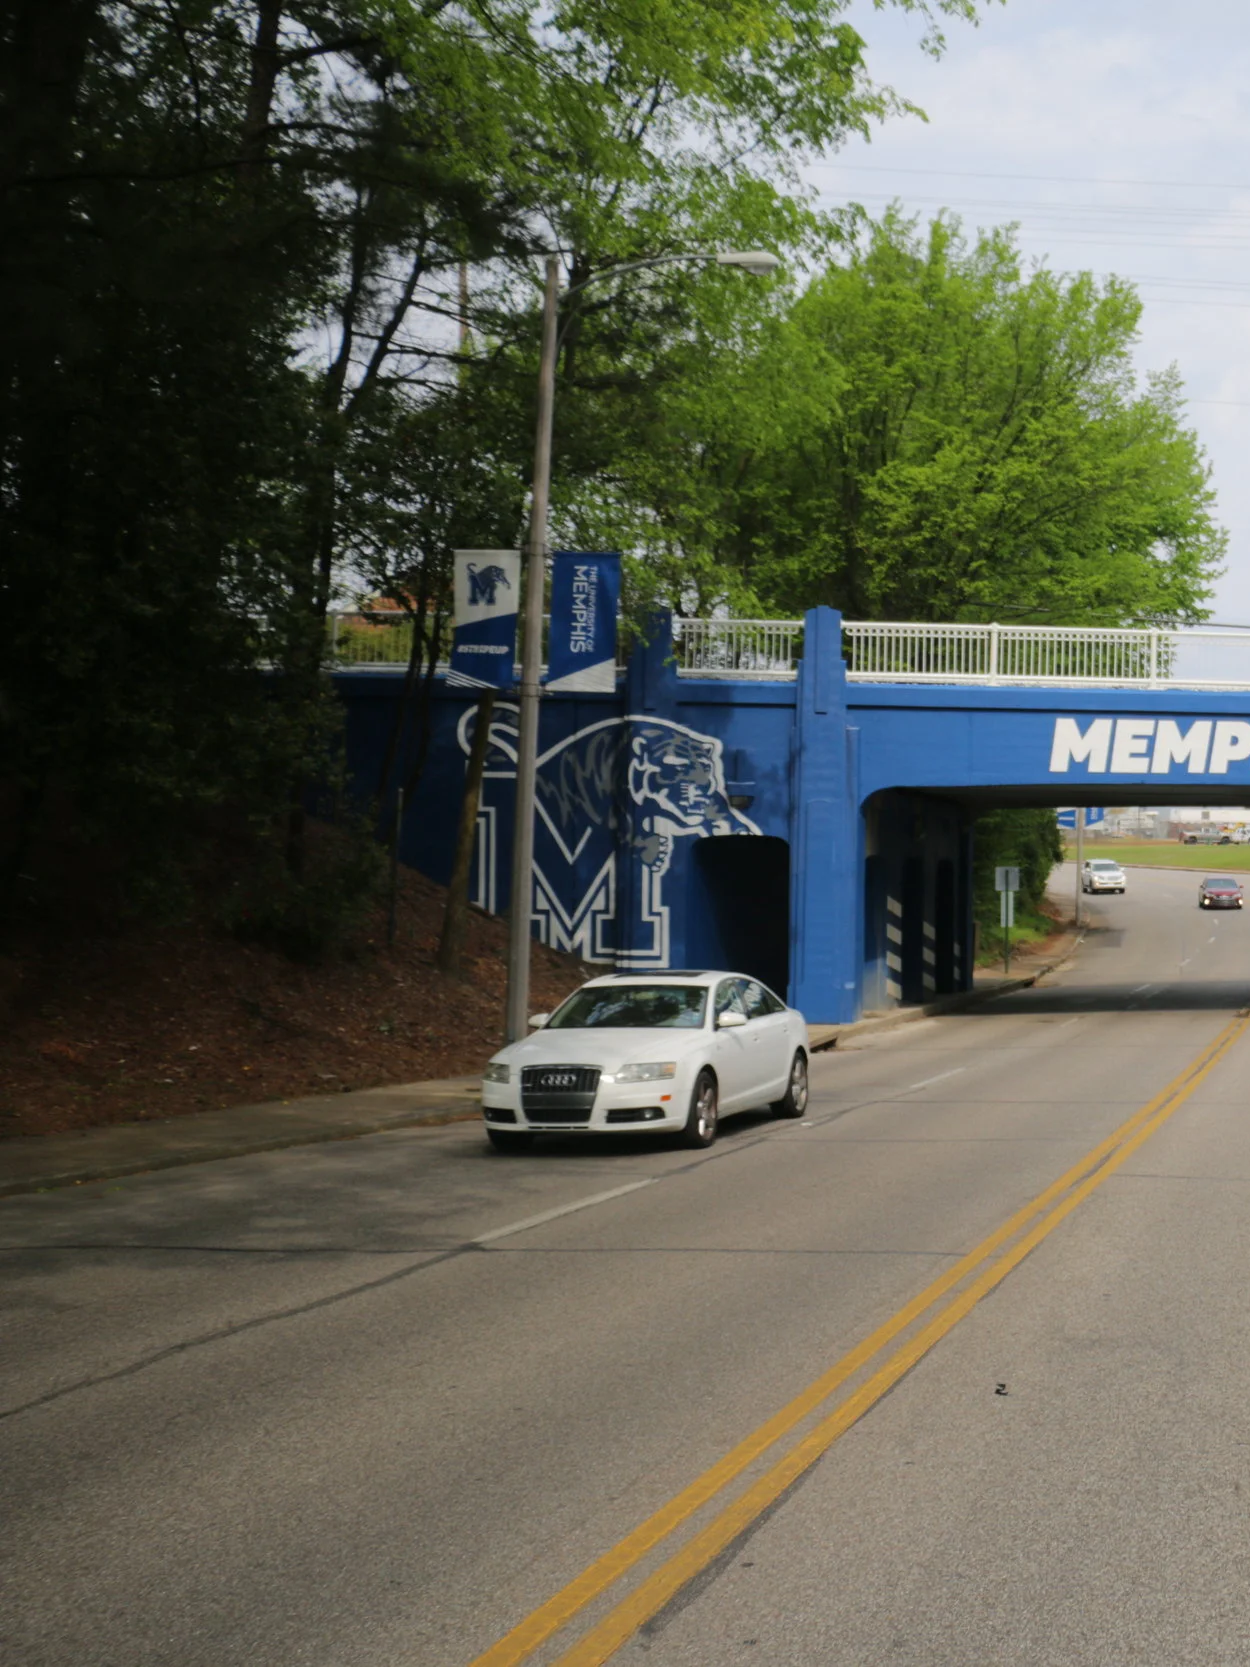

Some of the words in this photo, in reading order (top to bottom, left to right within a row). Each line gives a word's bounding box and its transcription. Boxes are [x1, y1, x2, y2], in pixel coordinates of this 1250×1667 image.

[588, 565, 598, 582] THE
[569, 564, 589, 653] MEMPHIS
[586, 585, 597, 638] UNIVERSITY
[584, 639, 595, 653] OF
